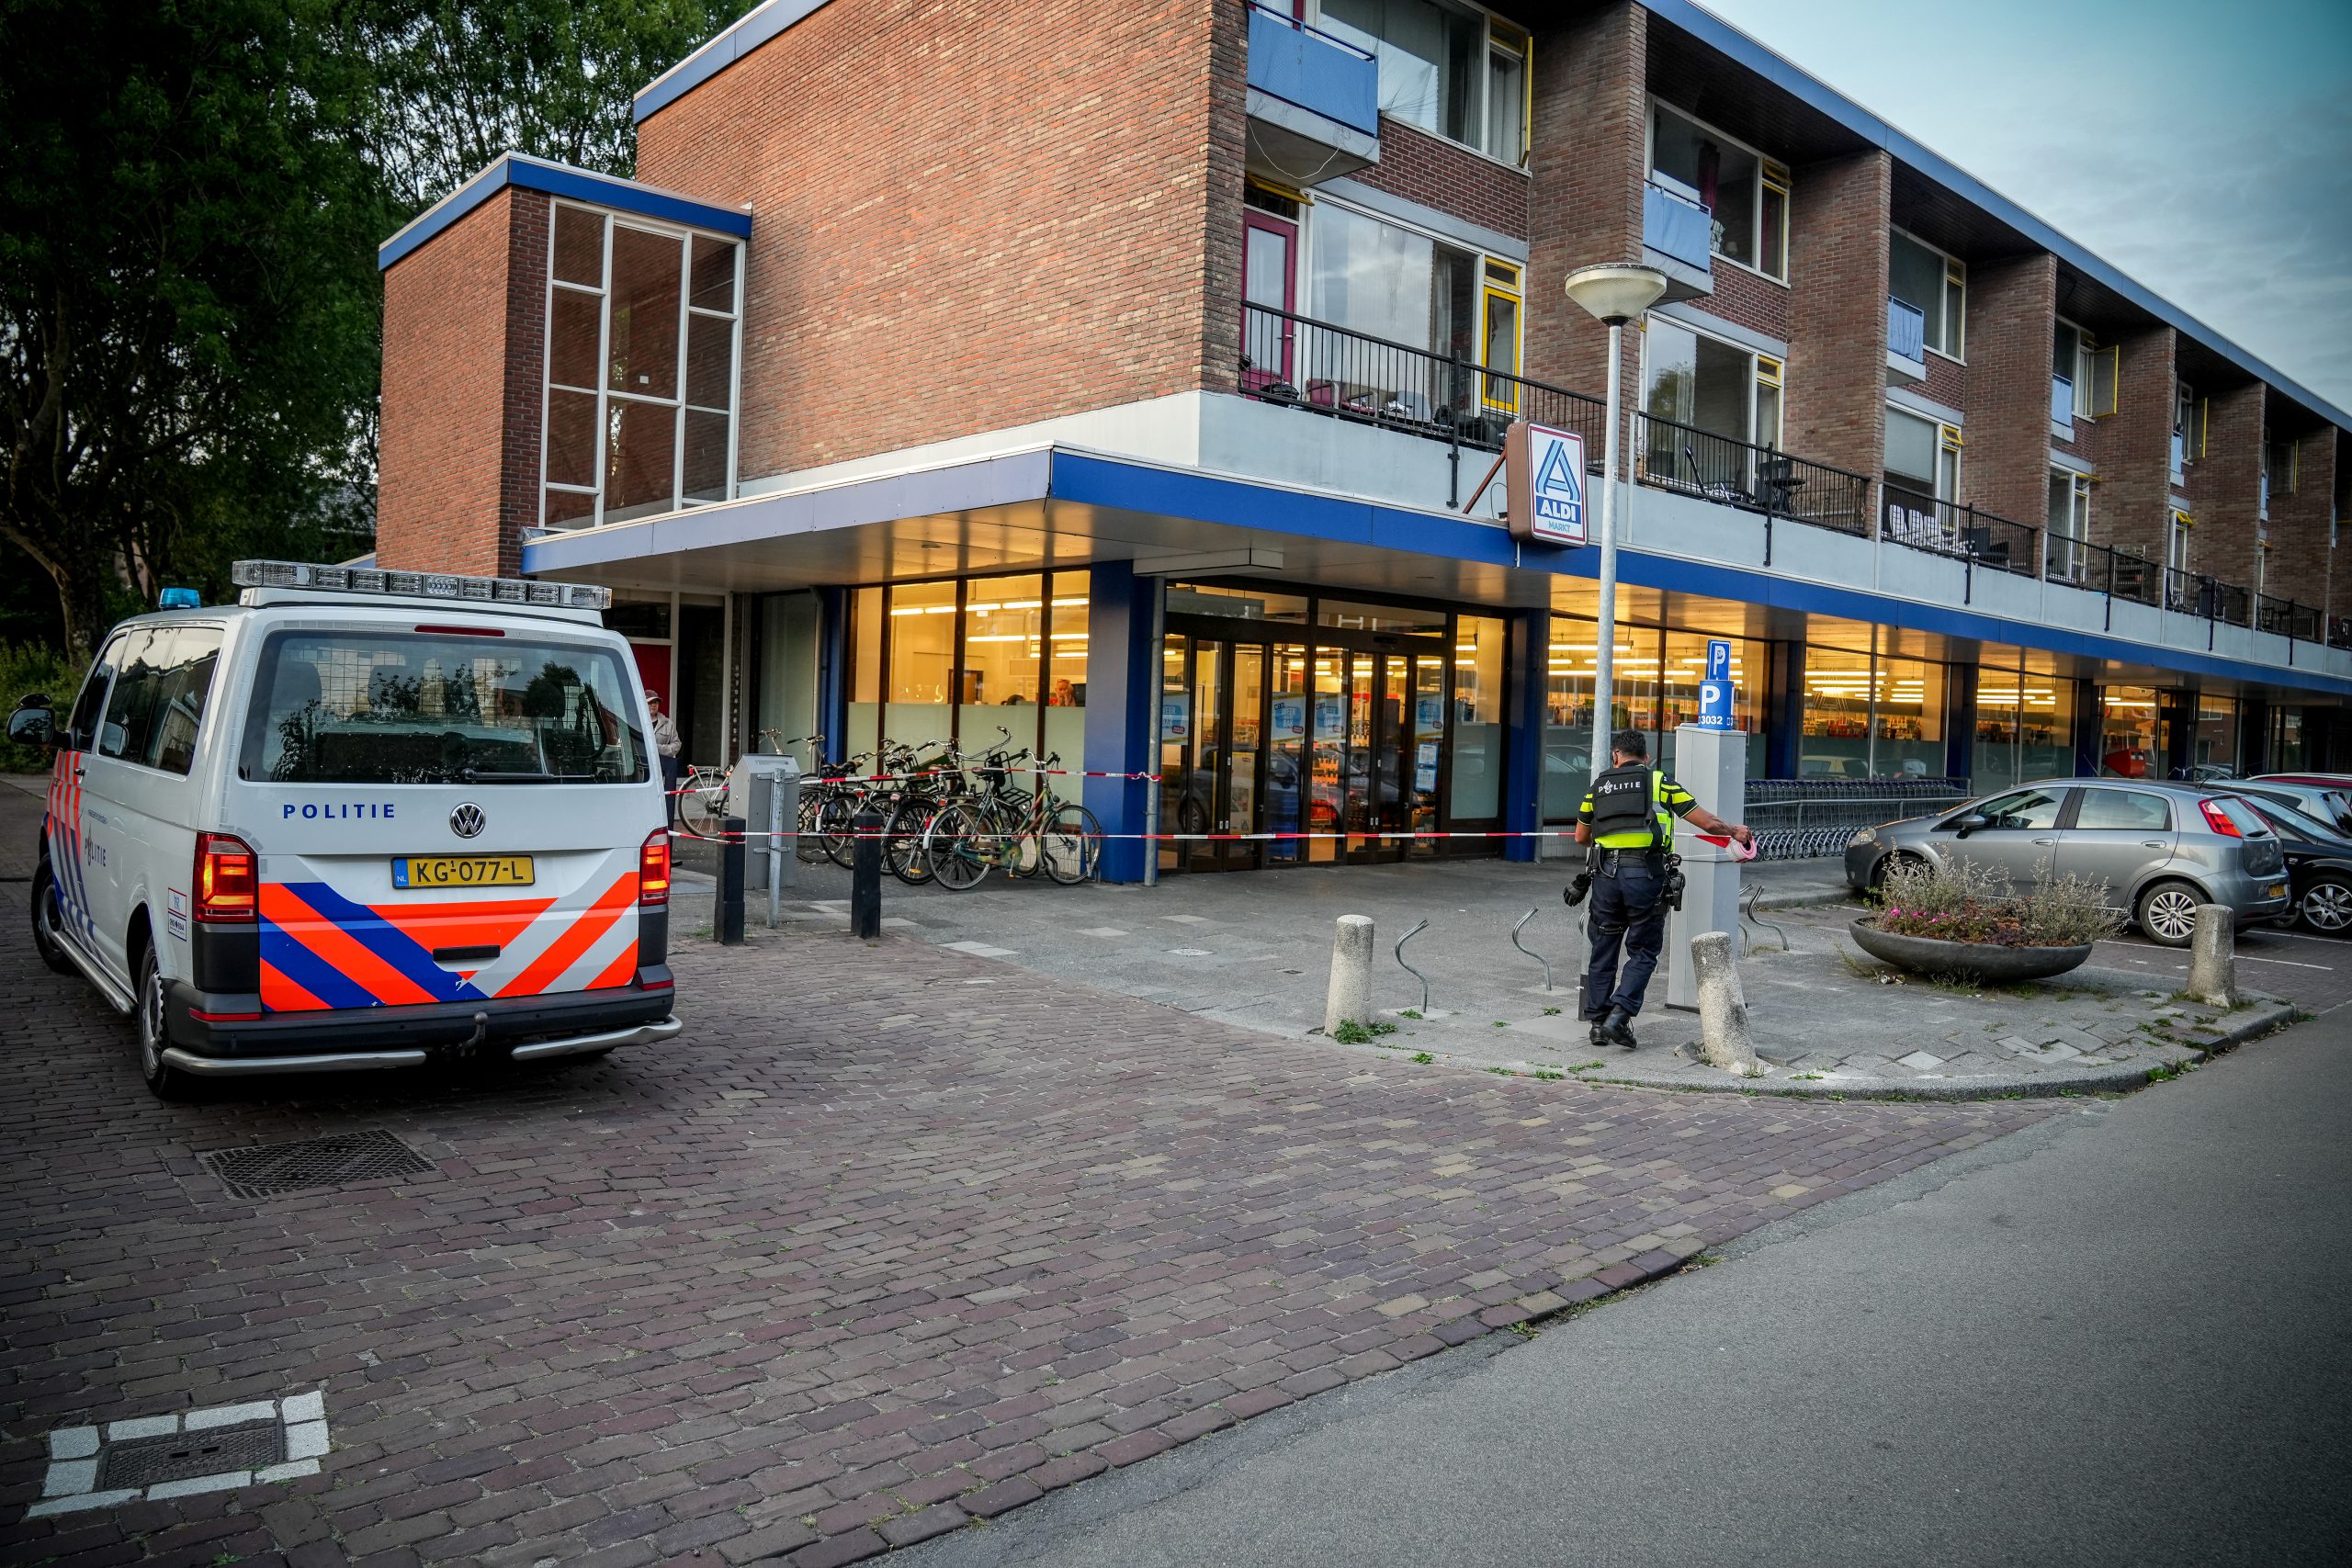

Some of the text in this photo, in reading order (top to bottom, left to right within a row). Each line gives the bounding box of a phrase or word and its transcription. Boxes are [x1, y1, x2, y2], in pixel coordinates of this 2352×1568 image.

[1540, 500, 1576, 521] ALDI
[1548, 521, 1570, 533] MARKT
[1702, 685, 1720, 714] P
[1599, 781, 1641, 794] POLITIE
[283, 804, 395, 818] POLITIE
[85, 831, 107, 867] POLITIE
